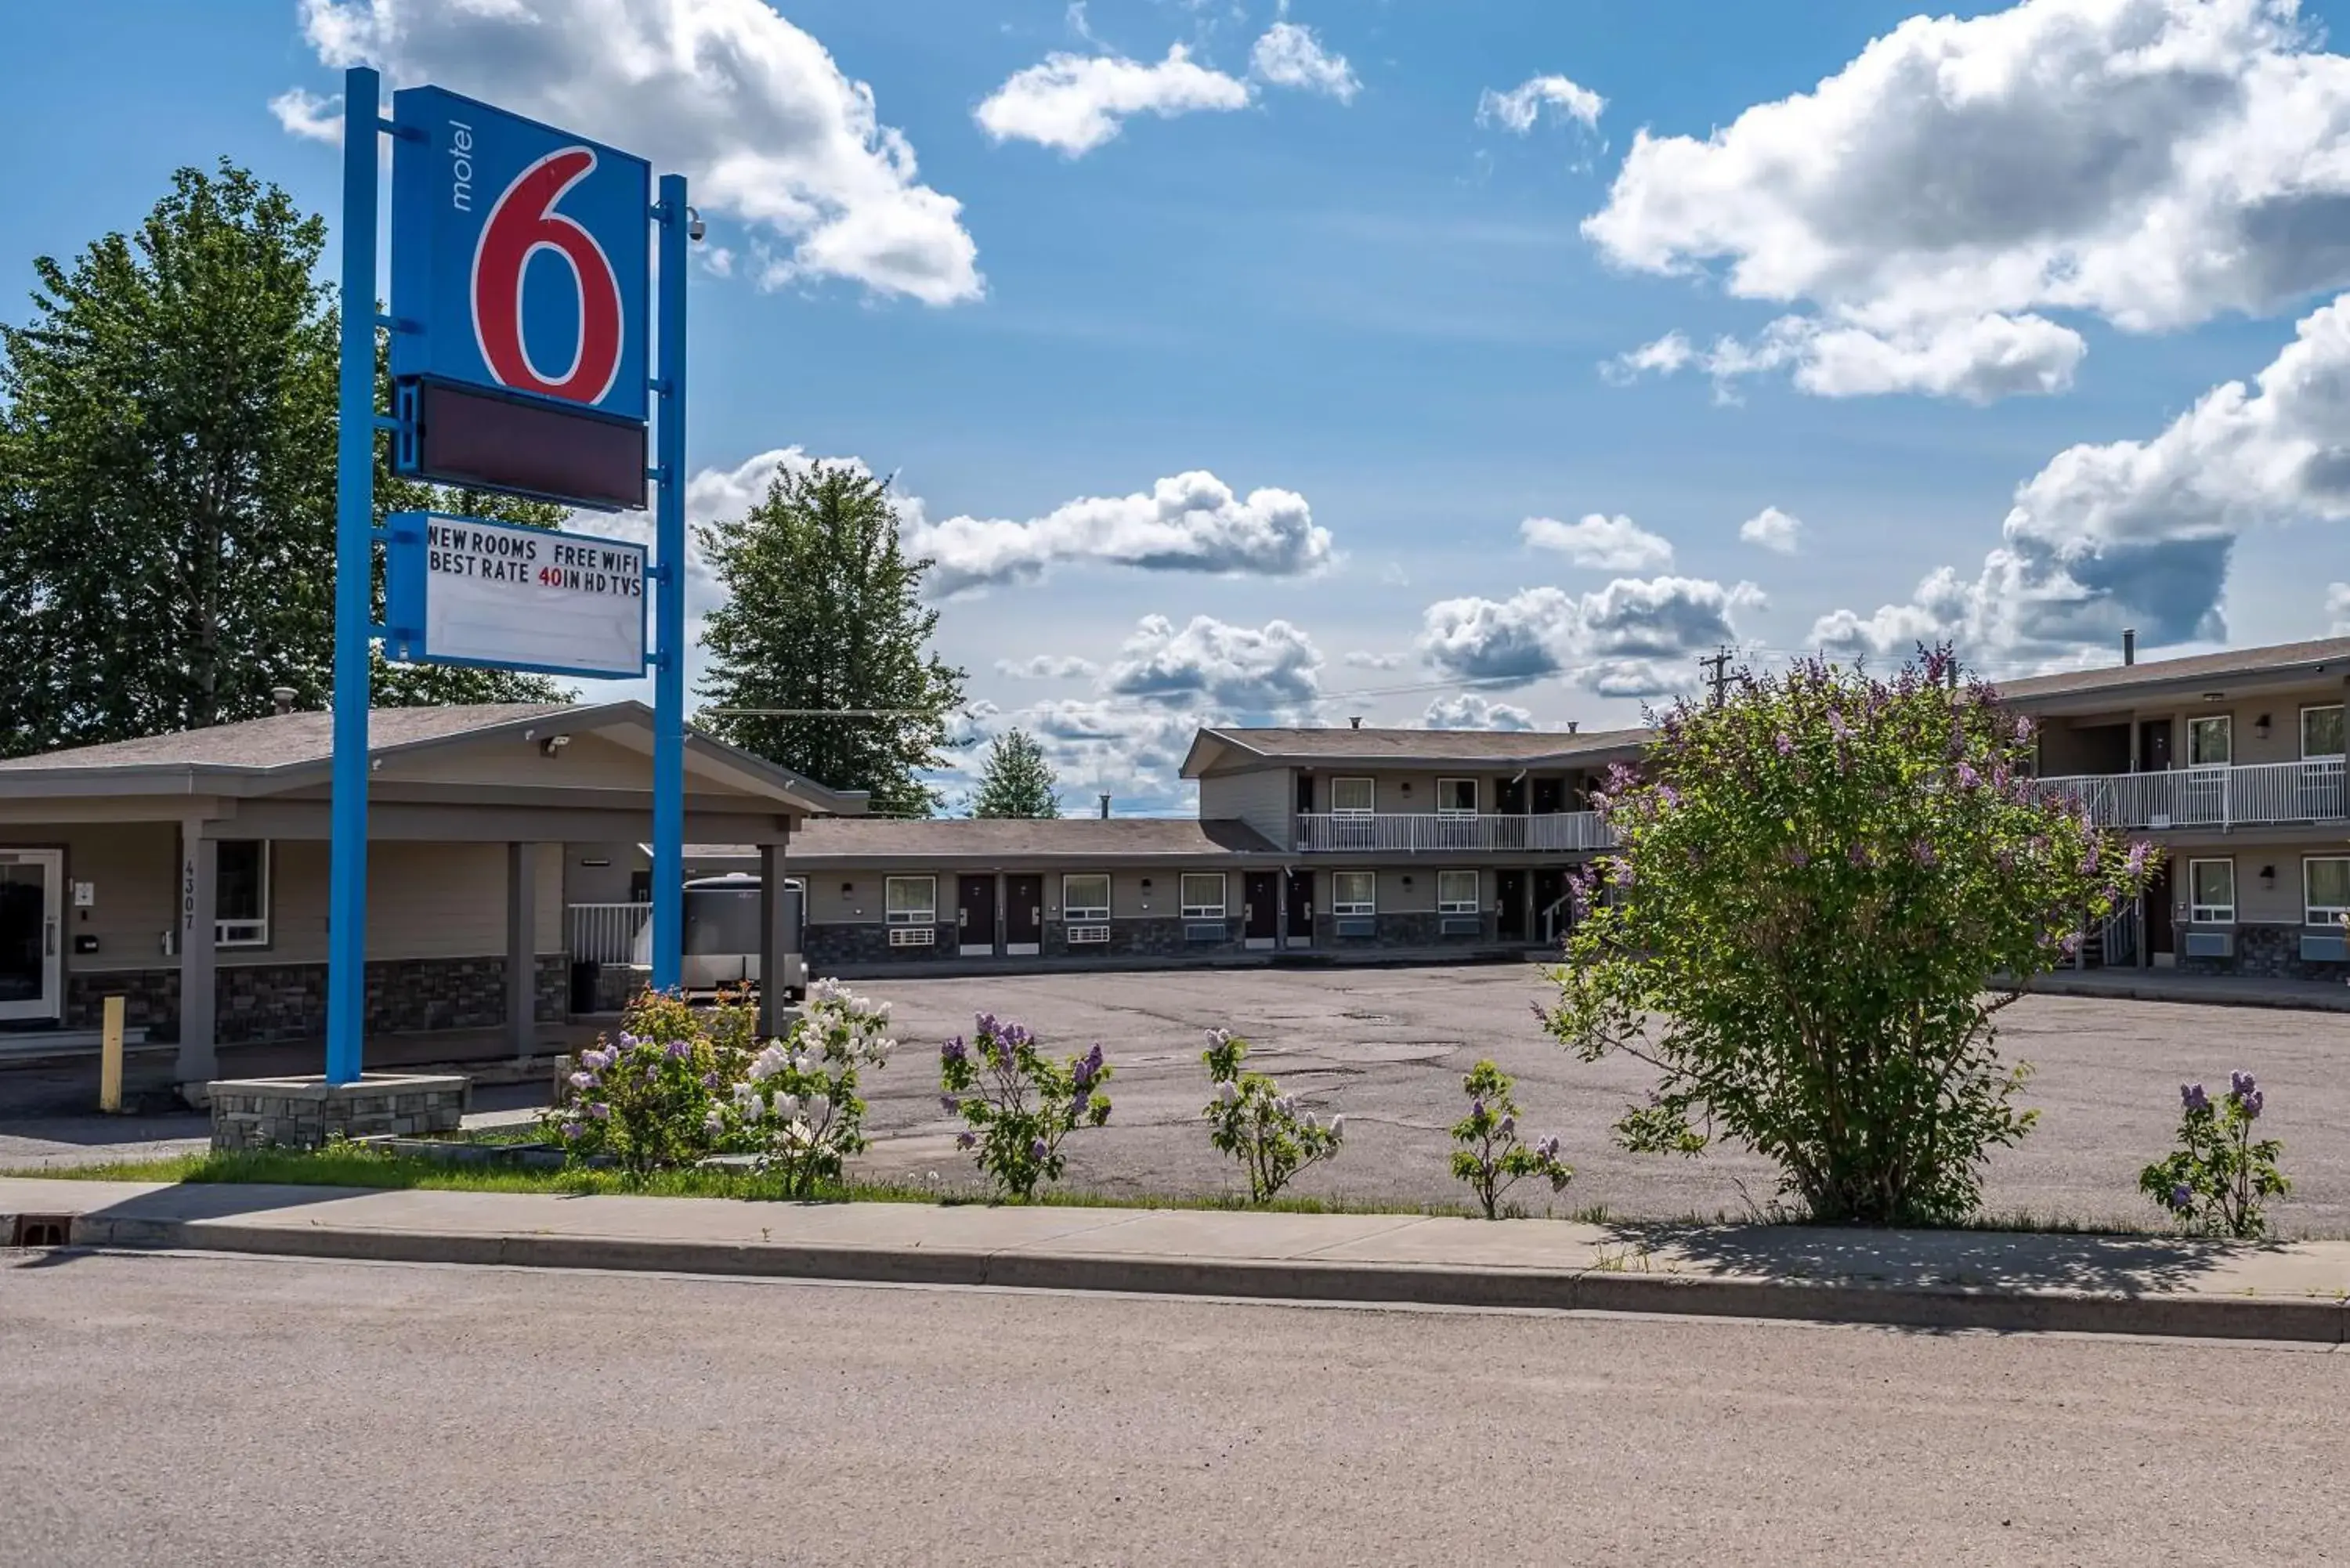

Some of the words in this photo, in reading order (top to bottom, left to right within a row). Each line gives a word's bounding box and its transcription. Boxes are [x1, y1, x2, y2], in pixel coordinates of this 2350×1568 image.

[449, 120, 472, 211] motel
[471, 146, 624, 406] 6
[428, 526, 467, 550] NEW
[472, 533, 537, 560] ROOMS
[555, 544, 597, 568] FREE
[602, 551, 638, 574] WIFI
[430, 551, 476, 576] BEST
[482, 558, 529, 583] RATE
[585, 572, 606, 592] HD
[611, 576, 641, 597] TVS
[185, 858, 194, 930] 4307
